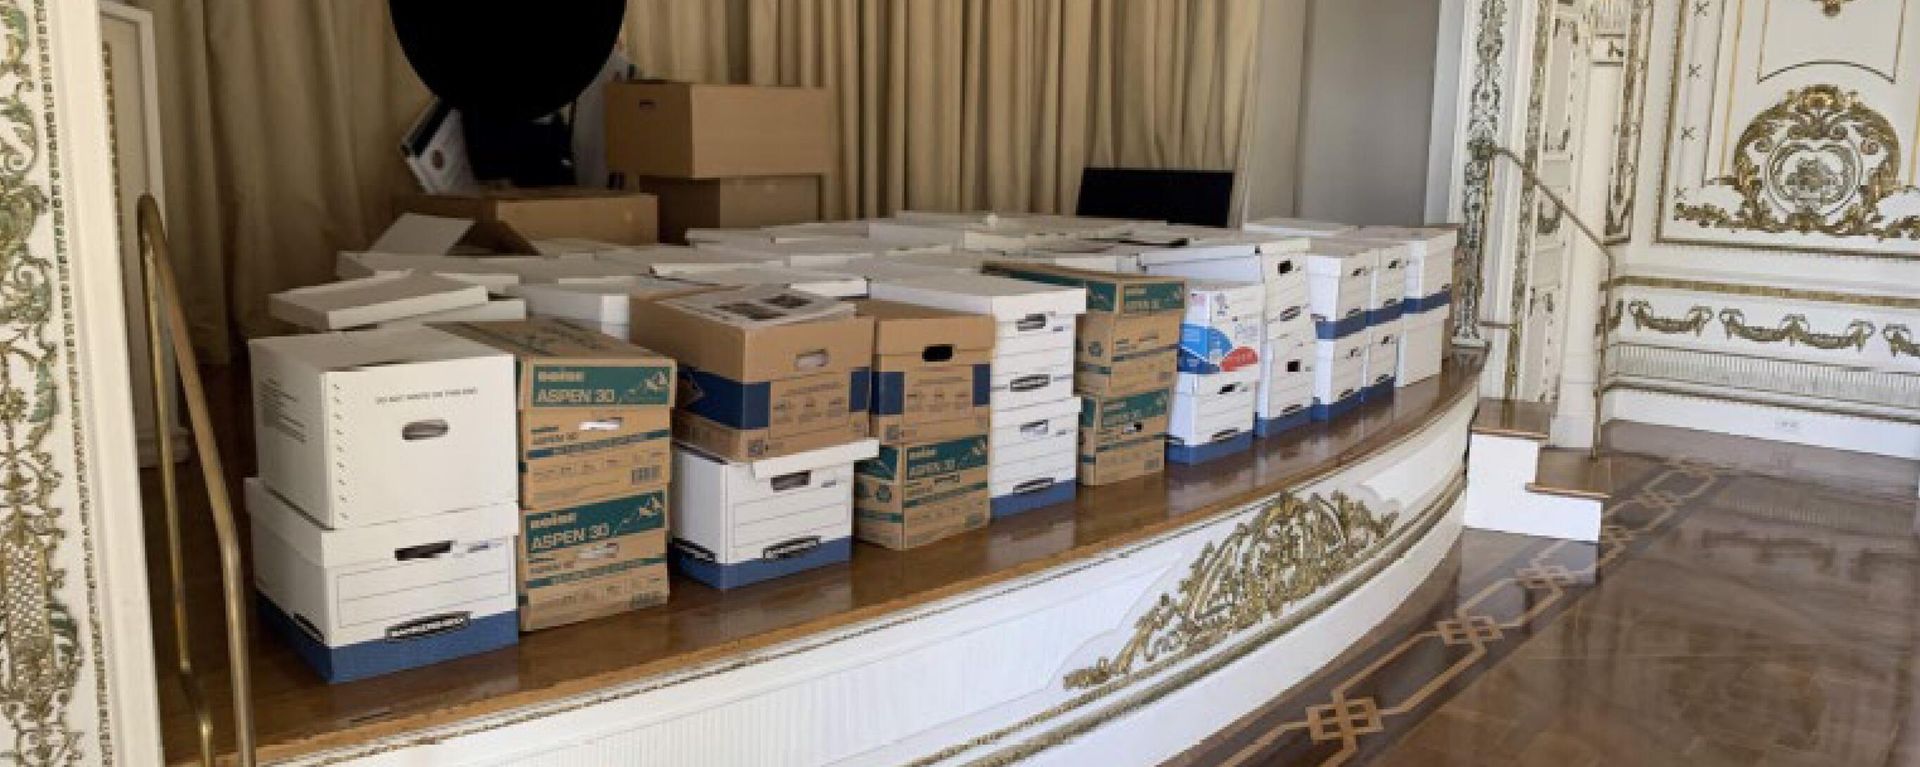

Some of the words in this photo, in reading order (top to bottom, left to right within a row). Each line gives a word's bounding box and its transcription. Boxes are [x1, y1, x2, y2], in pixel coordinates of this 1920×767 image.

[537, 388, 593, 403] ASPEN
[594, 388, 615, 403] 30
[529, 527, 585, 551] ASPEN
[588, 523, 610, 539] 30
